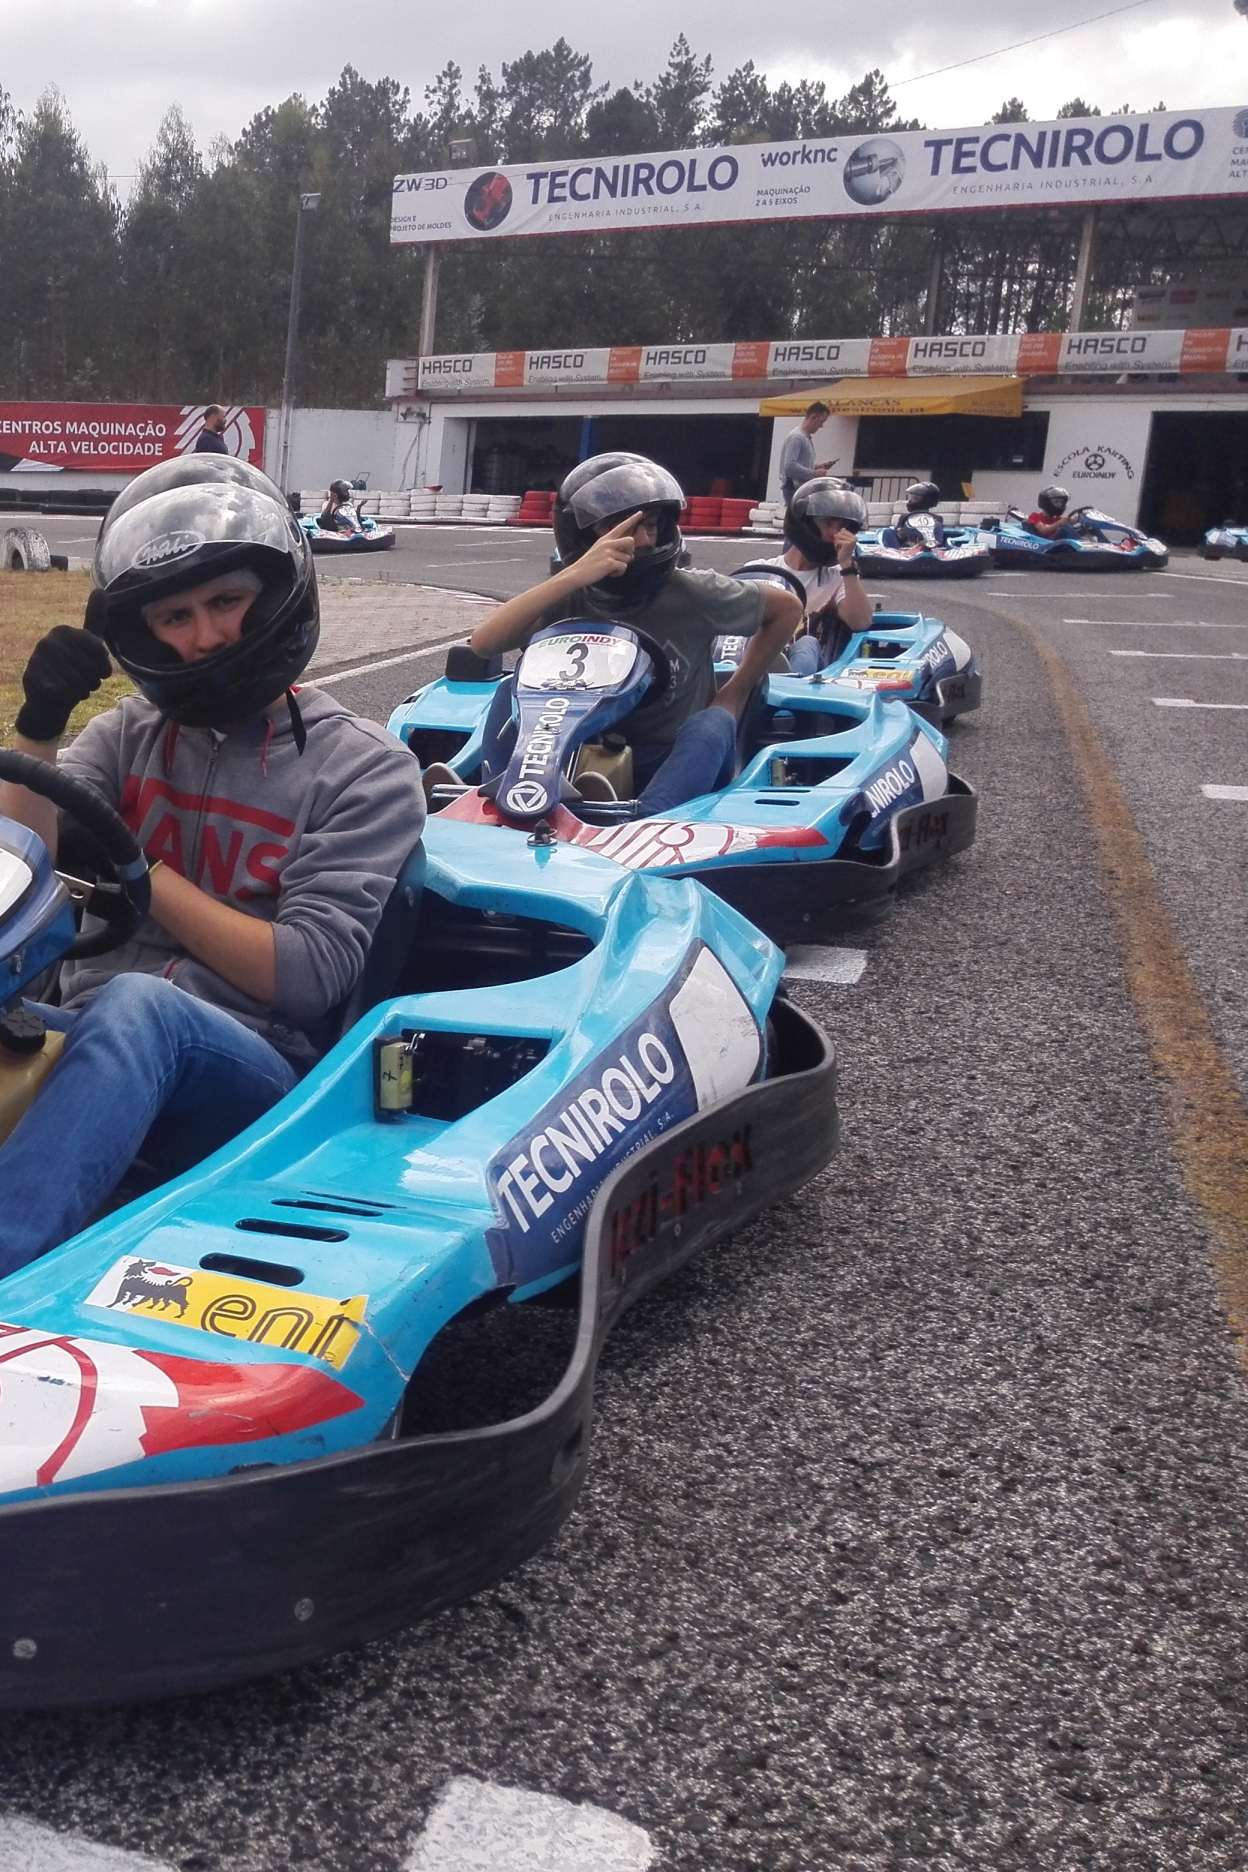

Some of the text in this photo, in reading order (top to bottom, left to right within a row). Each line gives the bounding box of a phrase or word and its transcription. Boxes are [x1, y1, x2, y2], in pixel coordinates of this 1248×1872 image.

[923, 118, 1205, 178] TECNIROLO
[525, 154, 739, 205] TECNIROLO
[952, 180, 1034, 195] ENGENHARIA
[756, 184, 811, 198] MAQUINAÇÃO
[774, 196, 798, 206] EIXOS
[549, 208, 612, 222] ENGENHARIA
[418, 223, 426, 231] DE
[426, 221, 452, 230] MOLDES
[773, 345, 840, 362] HASCO
[913, 341, 986, 359] HASCO
[1066, 337, 1147, 355] HASCO
[528, 354, 584, 370] HASCO
[645, 349, 706, 366] HASCO
[421, 359, 473, 375] HASCO
[65, 419, 166, 440] MAQUINAÇÃO
[28, 440, 163, 457] ALTA VELOCIDADE
[1097, 446, 1134, 480] KARTING
[537, 635, 621, 649] EUROINDY
[559, 642, 589, 680] 3
[865, 760, 915, 815] NIROLO
[497, 1031, 675, 1234] TECNIROLO
[200, 1294, 354, 1361] eni
